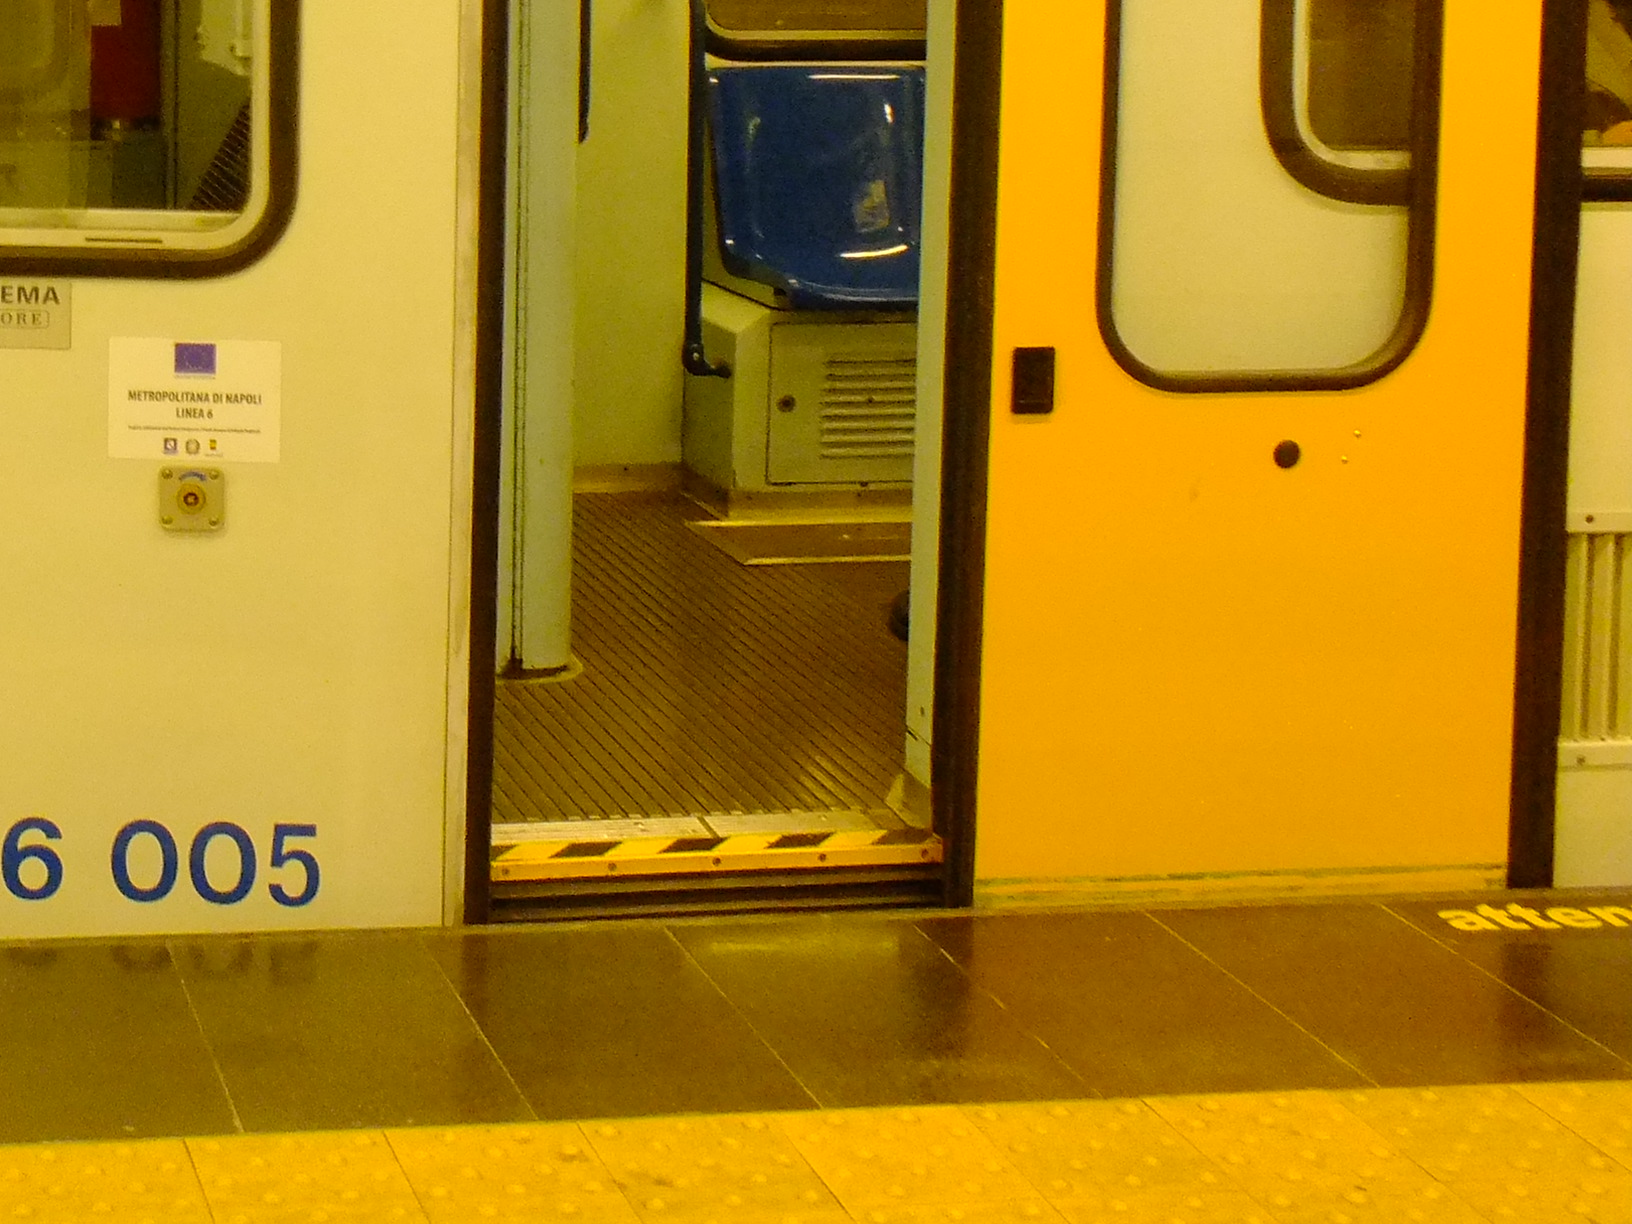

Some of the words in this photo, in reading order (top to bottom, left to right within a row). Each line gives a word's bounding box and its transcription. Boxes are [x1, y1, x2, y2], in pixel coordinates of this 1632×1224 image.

[128, 390, 210, 403] METROPOLITANA
[213, 392, 223, 403] DI
[226, 393, 262, 405] NAPOLI
[176, 407, 204, 419] LINEA
[207, 409, 213, 419] 6
[111, 819, 320, 907] 005
